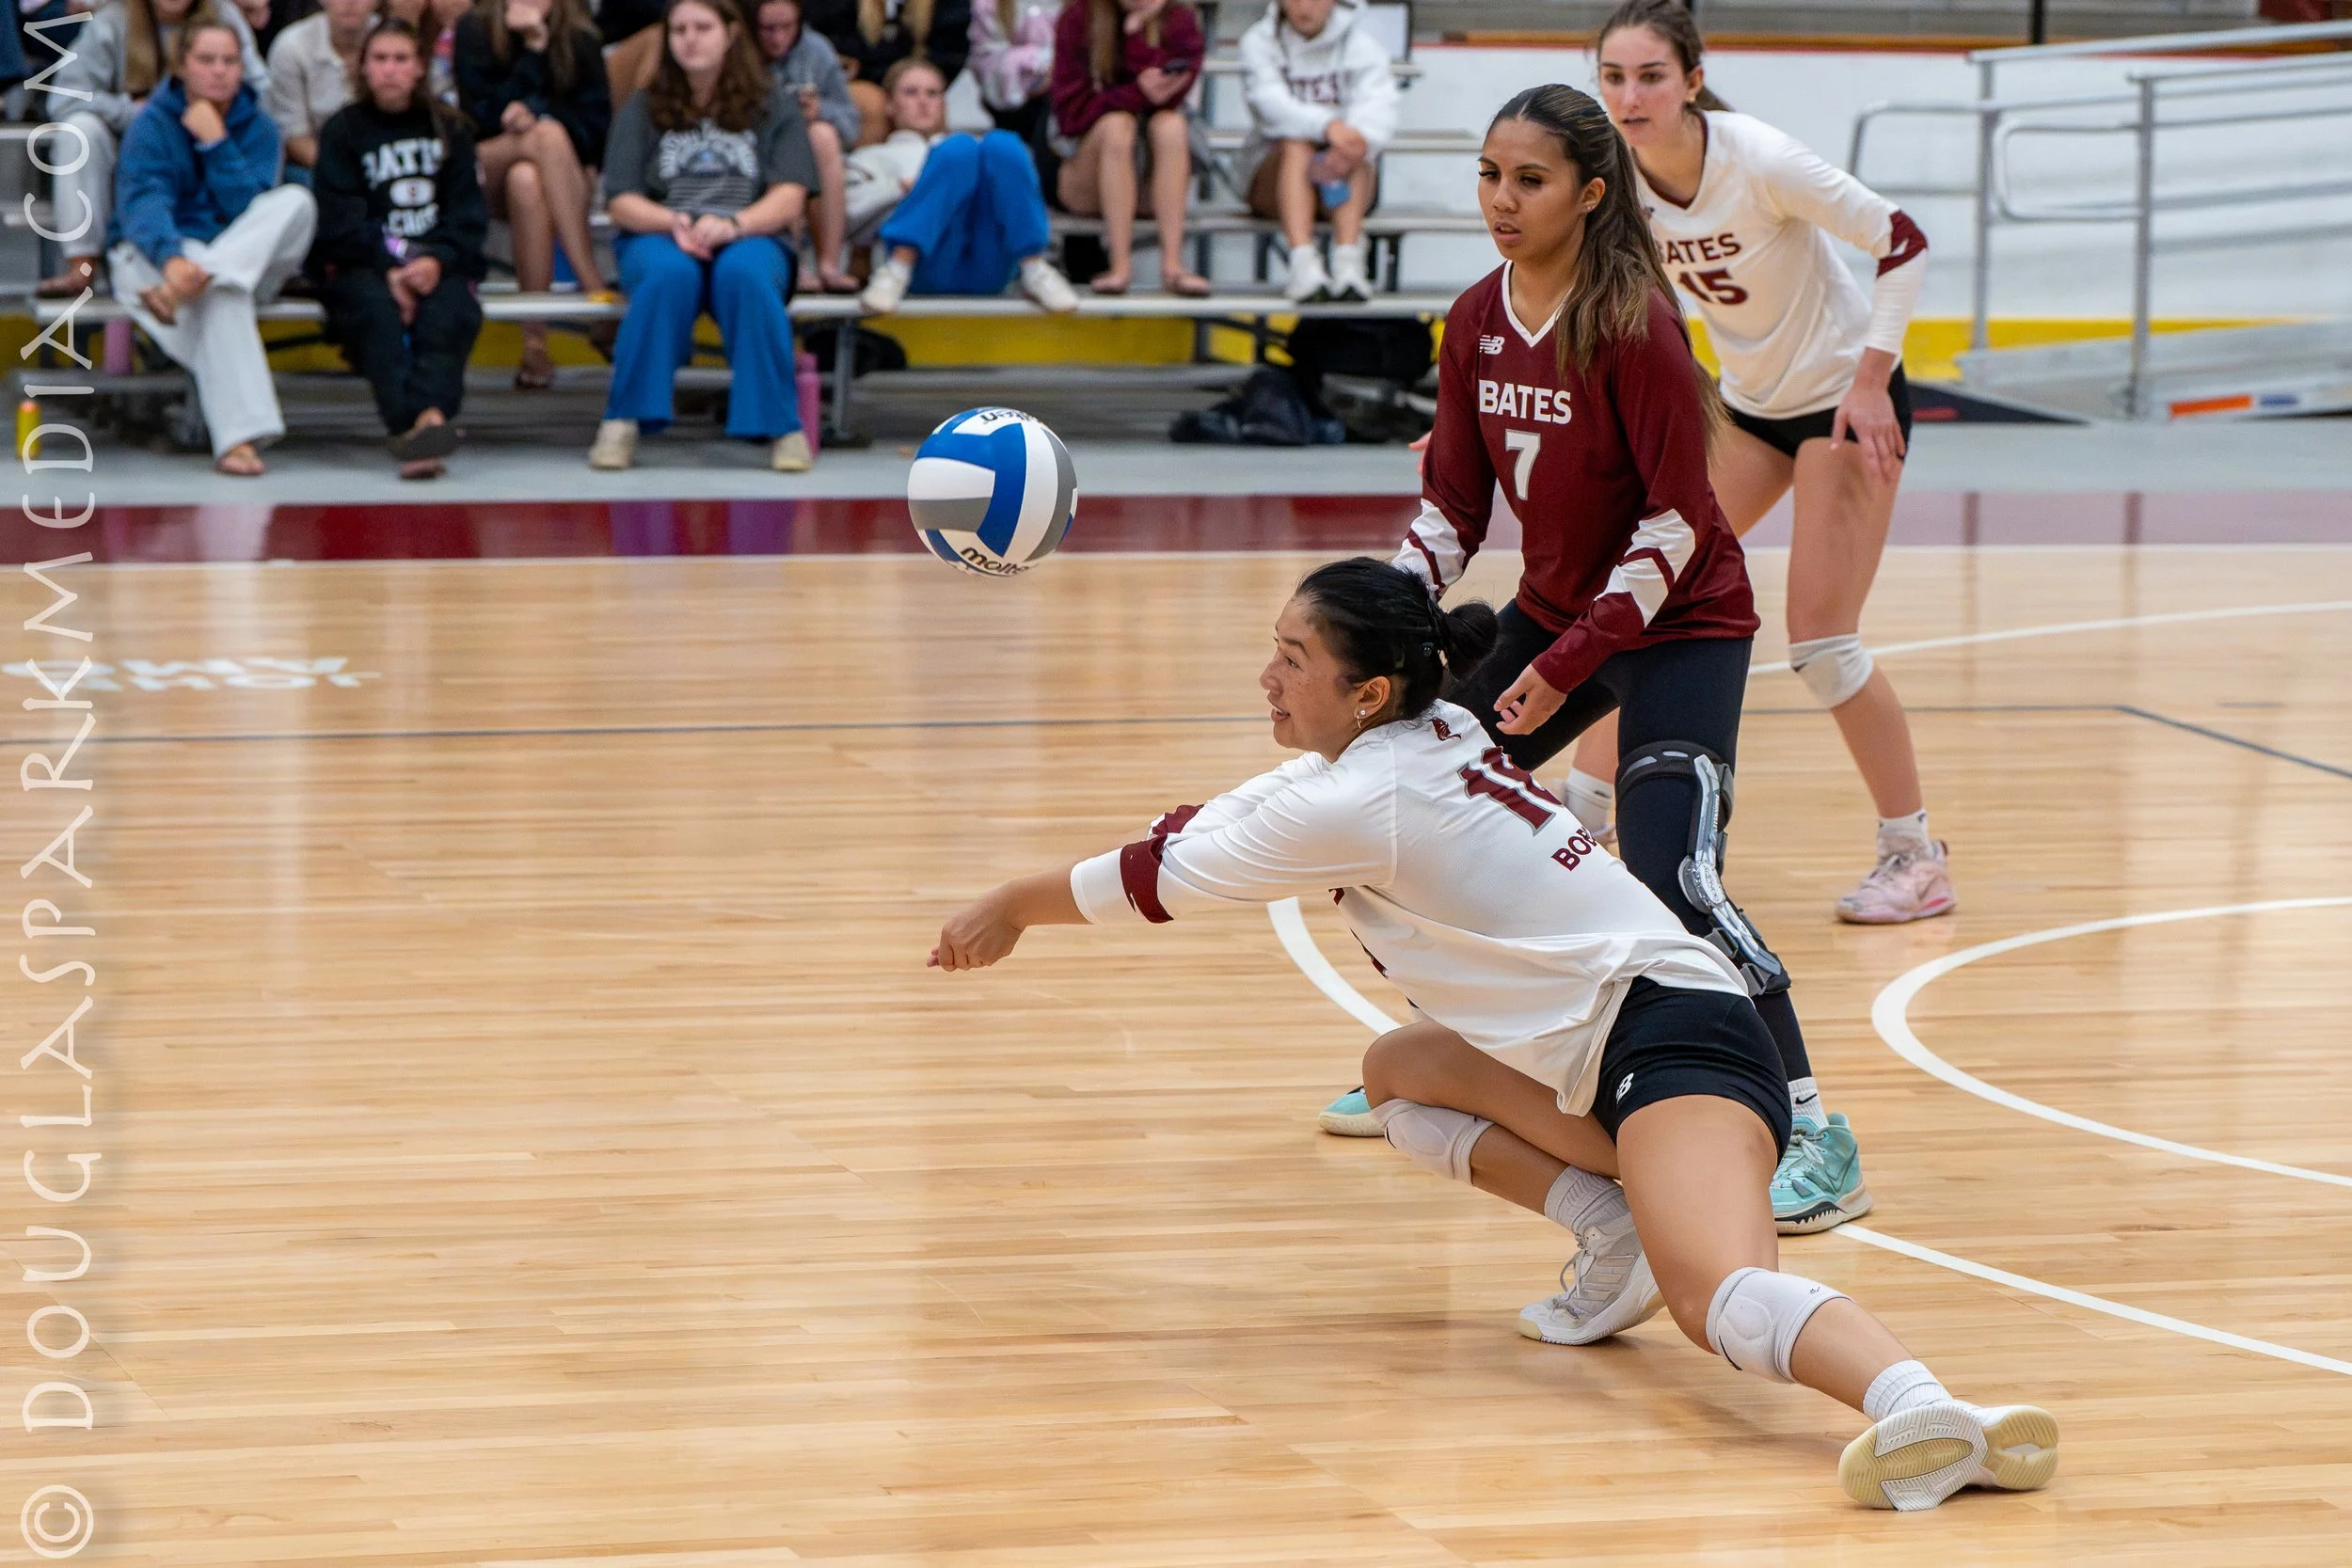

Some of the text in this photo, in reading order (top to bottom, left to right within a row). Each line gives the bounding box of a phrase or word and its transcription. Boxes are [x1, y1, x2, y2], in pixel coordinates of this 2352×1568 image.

[1677, 266, 1749, 306] 15
[1478, 379, 1573, 425] BATES
[1504, 428, 1542, 501] 7
